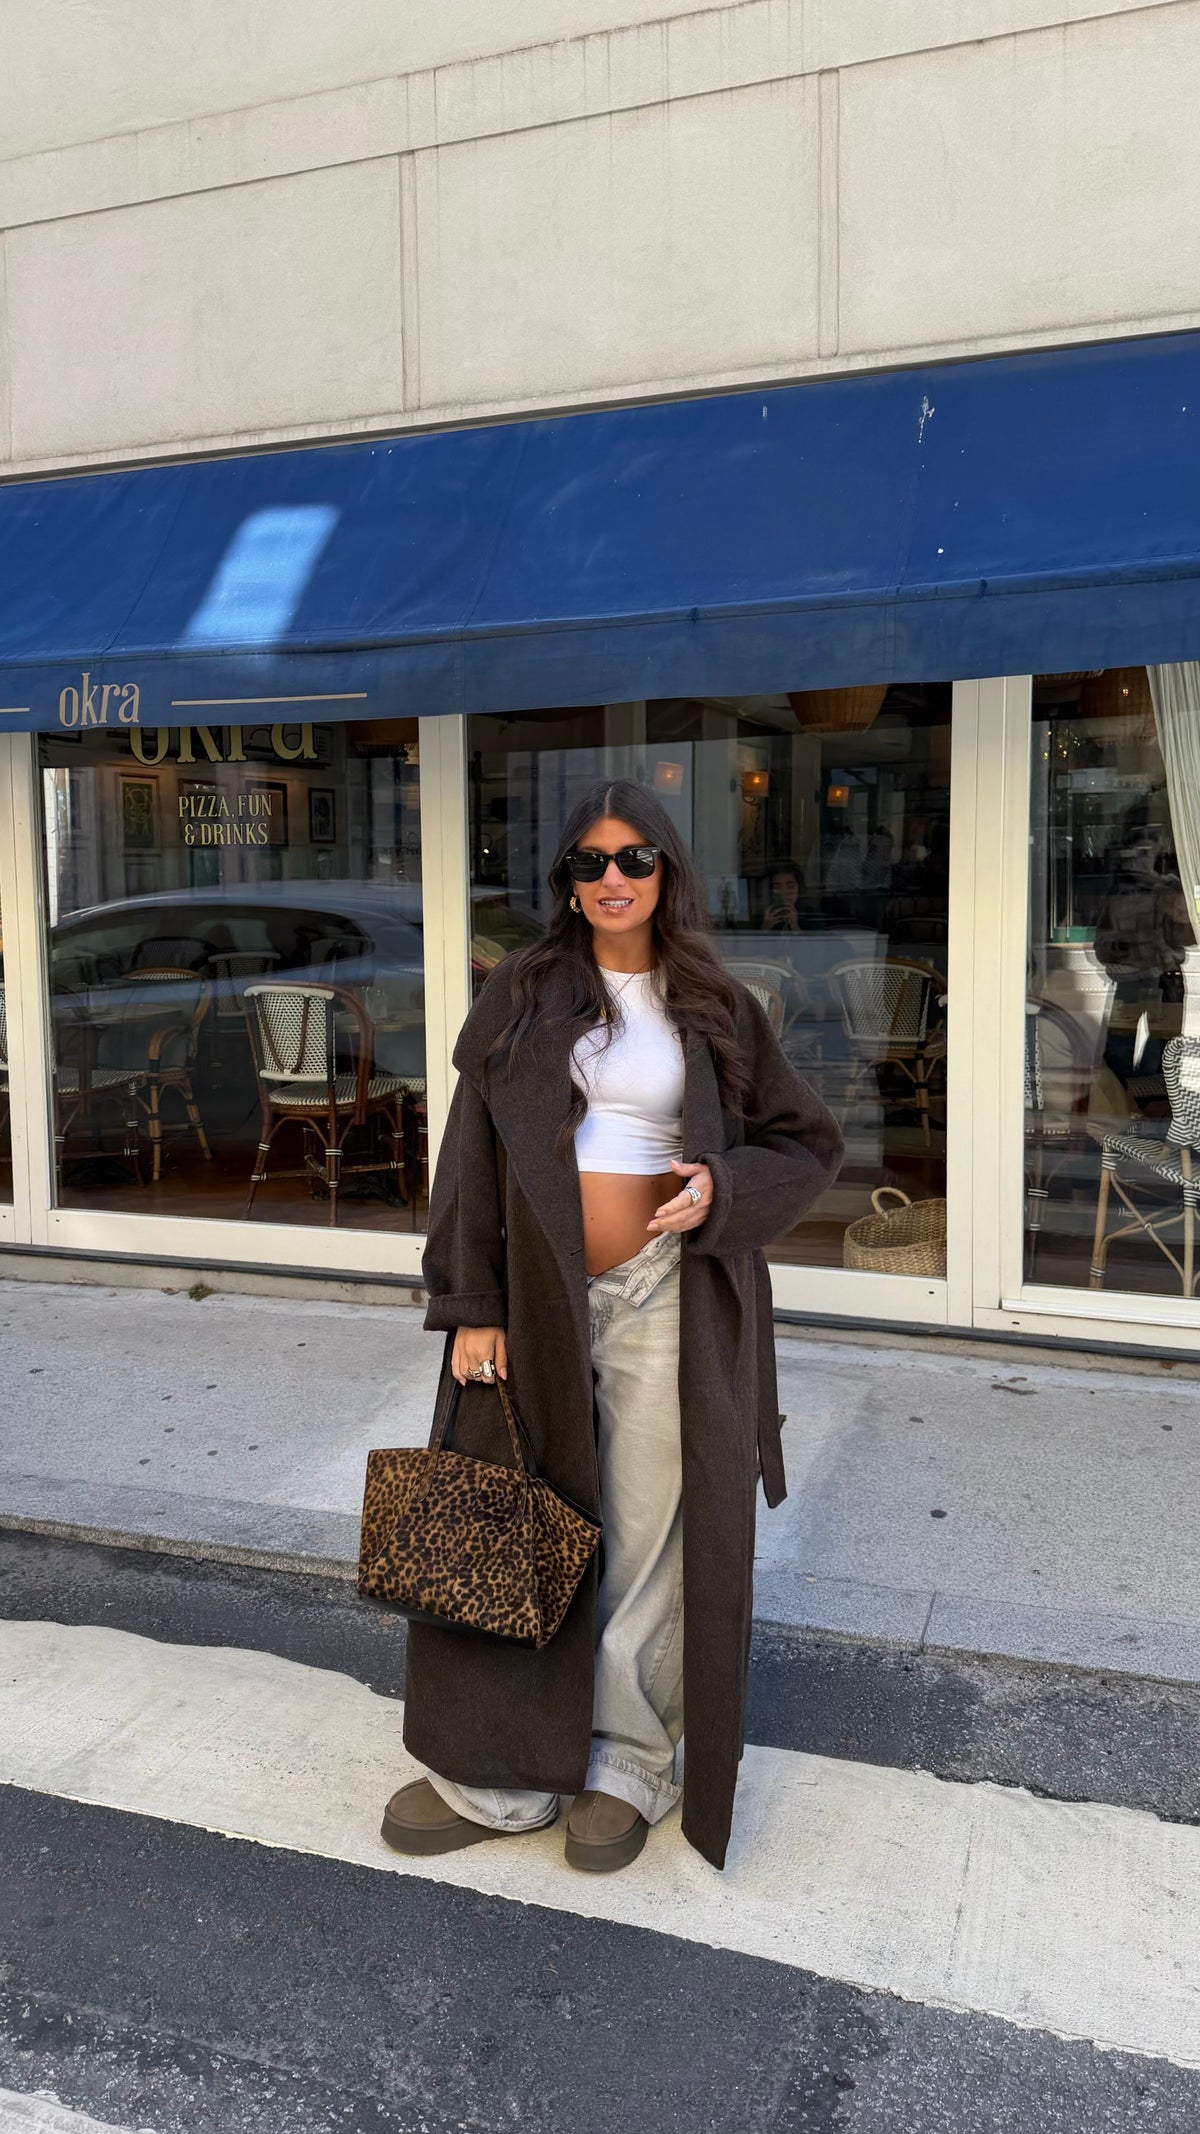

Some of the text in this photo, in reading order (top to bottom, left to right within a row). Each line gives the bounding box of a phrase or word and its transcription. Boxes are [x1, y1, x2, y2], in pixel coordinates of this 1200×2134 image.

[59, 672, 140, 727] okra
[178, 794, 273, 819] PIZZA, FUN
[184, 822, 269, 846] & DRINKS
